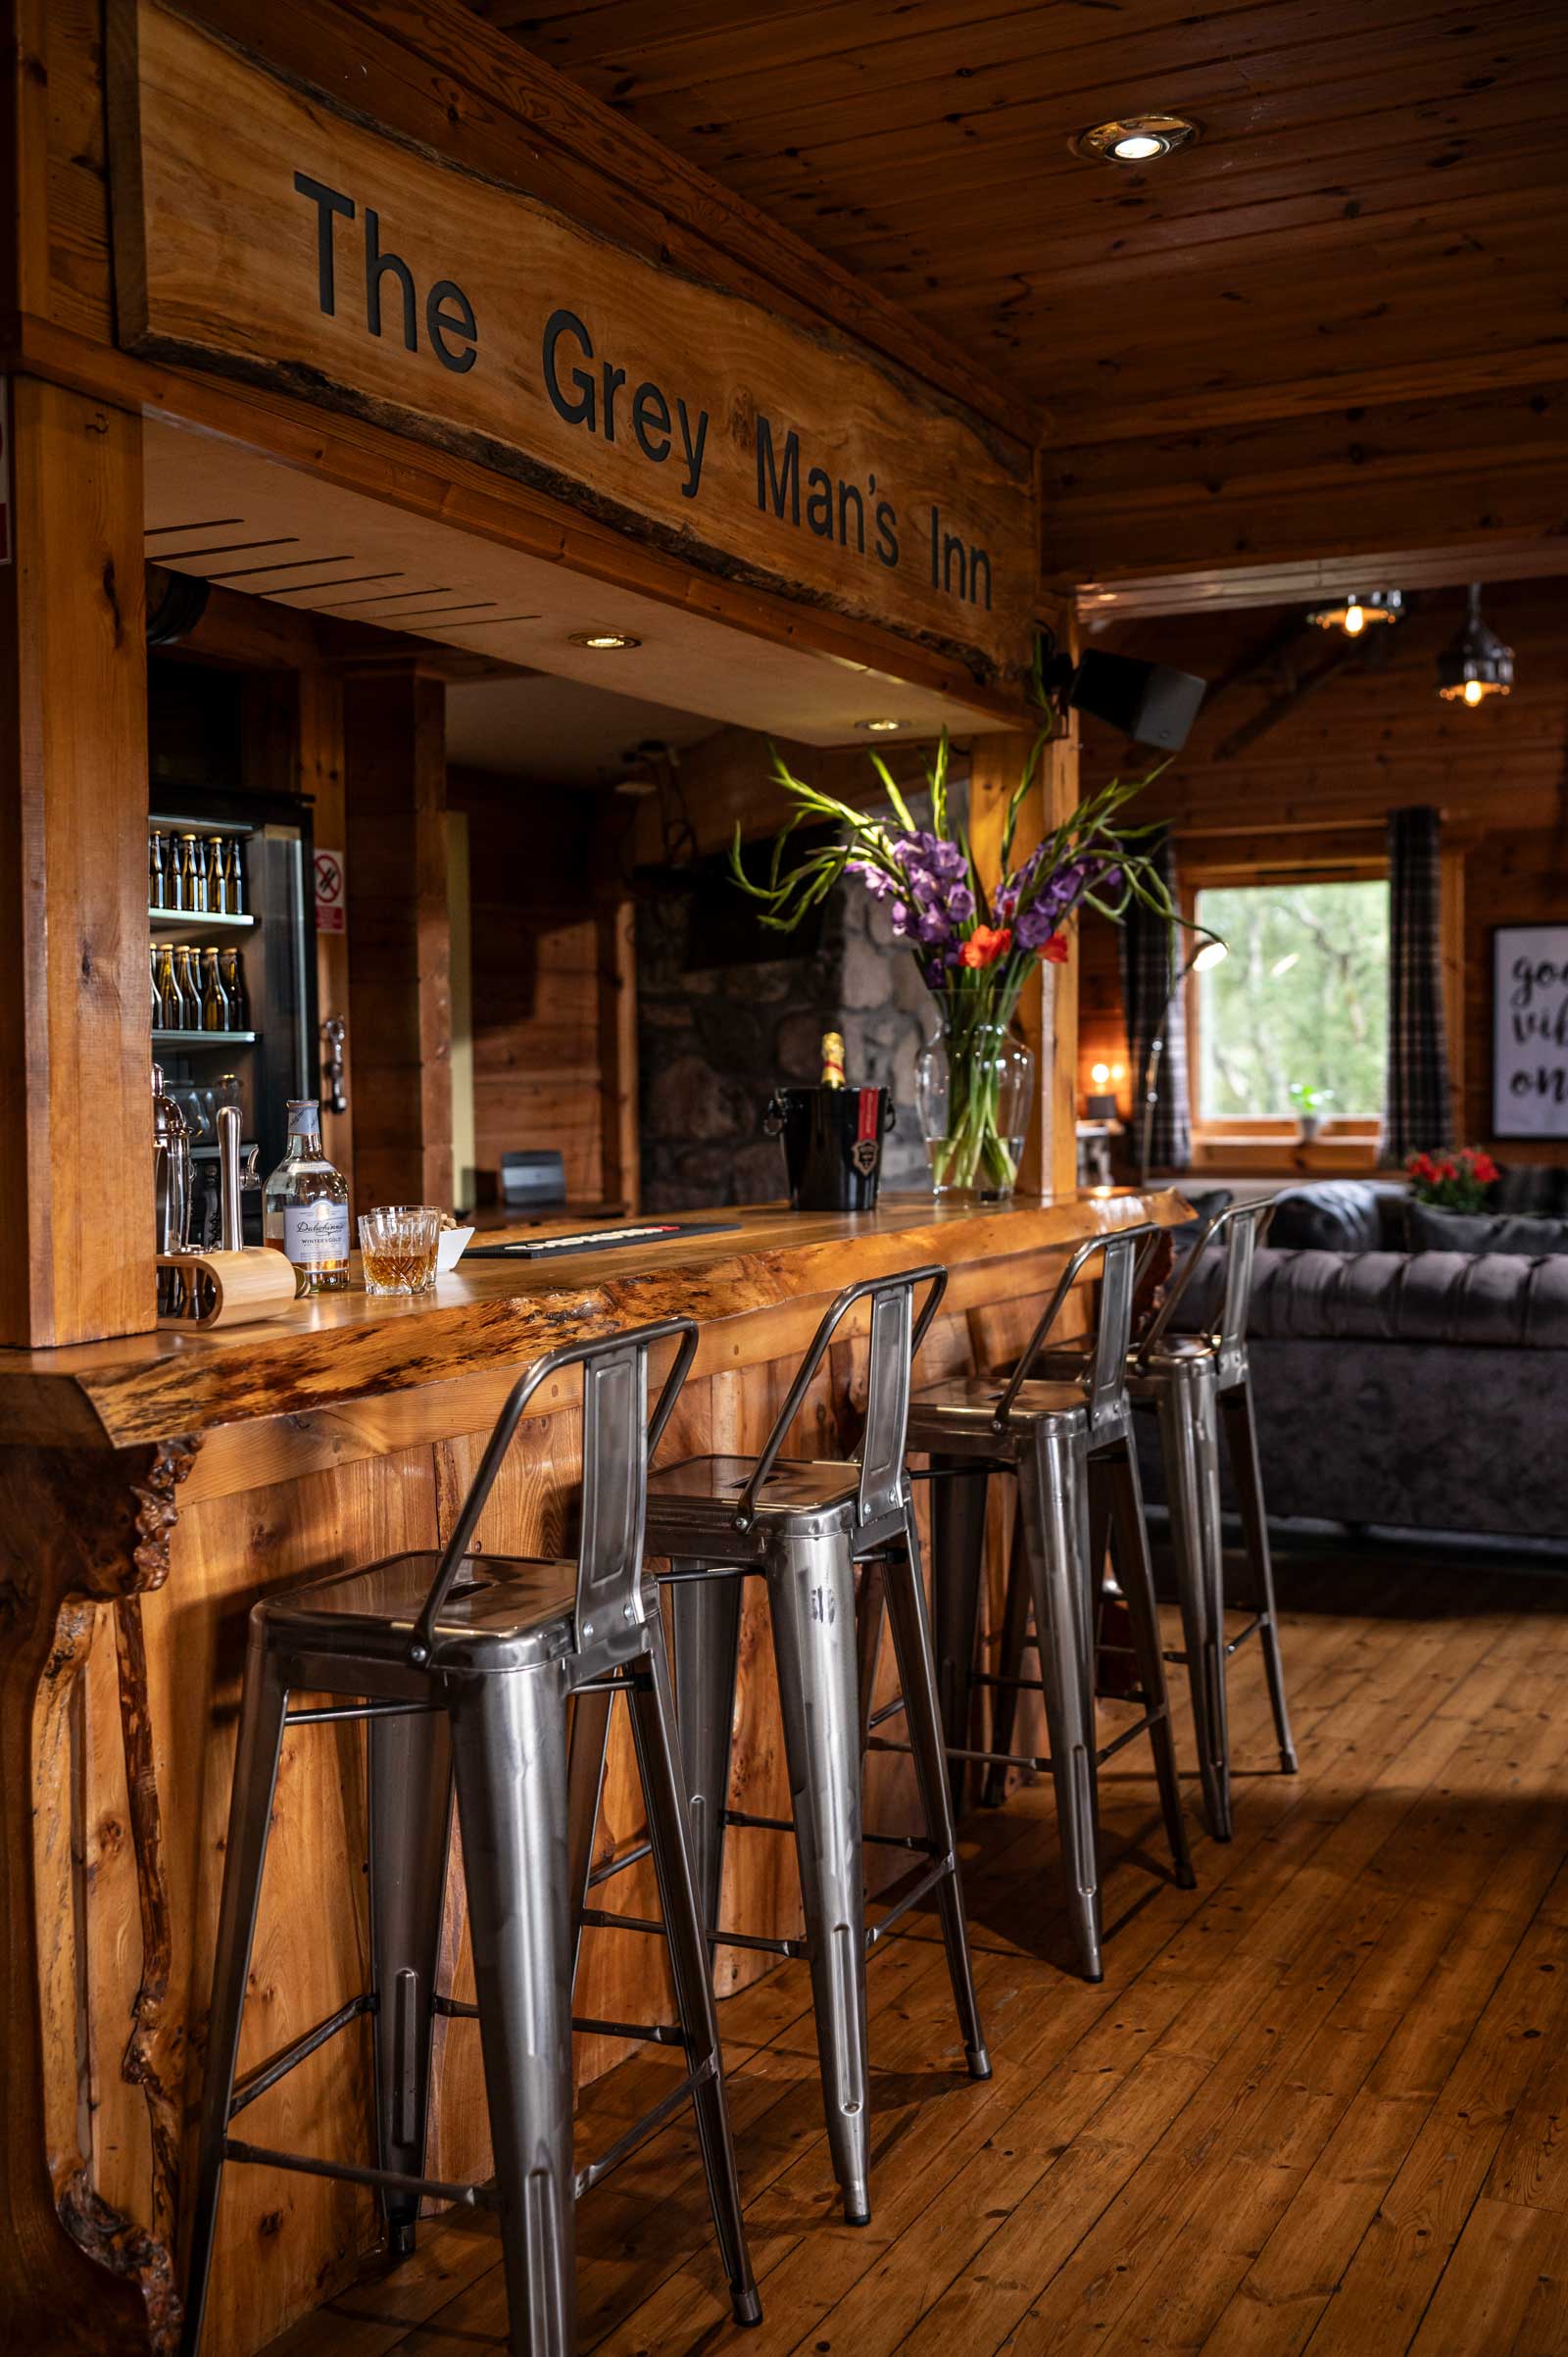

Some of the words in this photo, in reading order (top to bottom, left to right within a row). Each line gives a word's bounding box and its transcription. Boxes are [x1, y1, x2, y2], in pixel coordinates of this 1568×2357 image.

[293, 172, 477, 373] The
[542, 309, 709, 498] Grey
[757, 416, 901, 567] Man's
[931, 507, 993, 611] Inn
[1510, 1064, 1568, 1102] on
